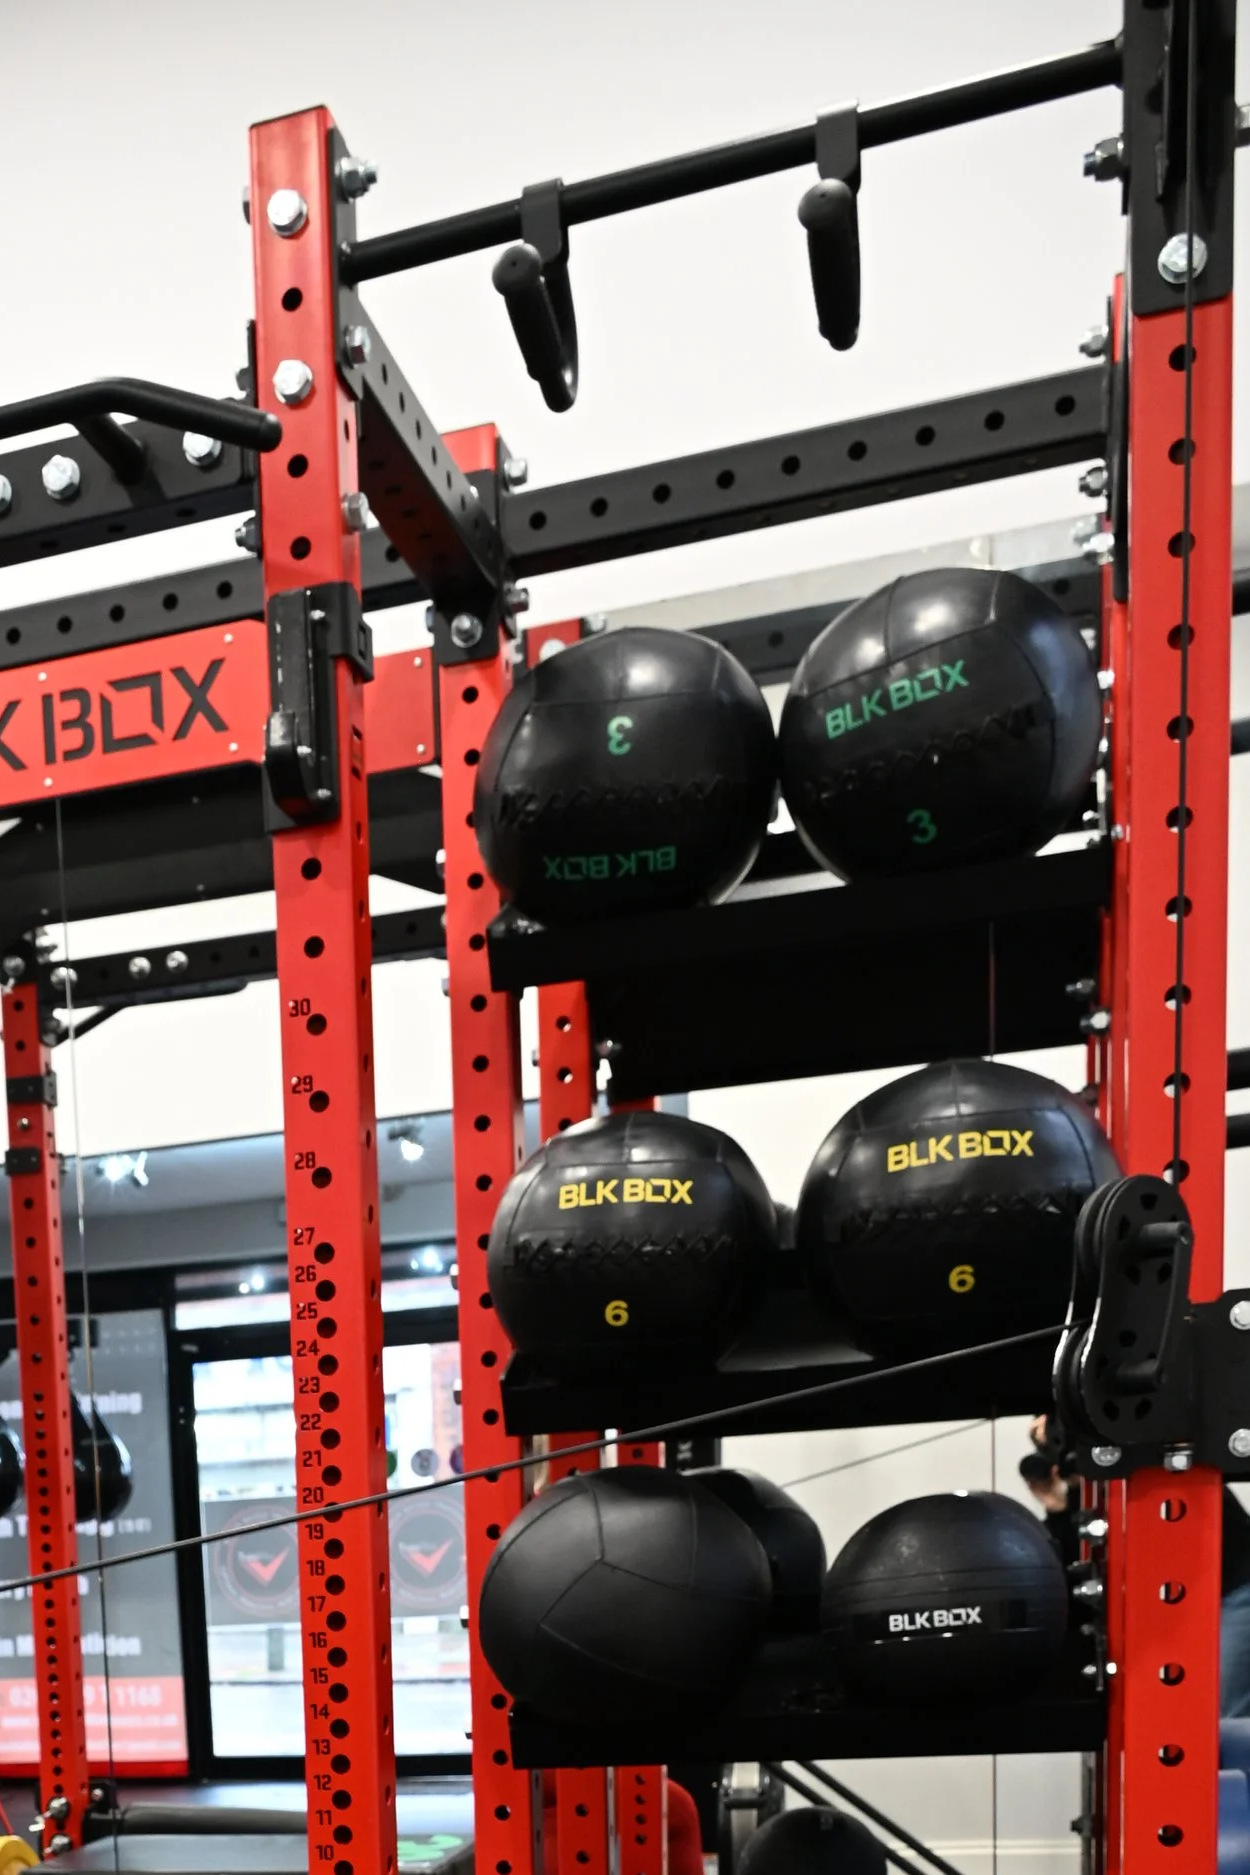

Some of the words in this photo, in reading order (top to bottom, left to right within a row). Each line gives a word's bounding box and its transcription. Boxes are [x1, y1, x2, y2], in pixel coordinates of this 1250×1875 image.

[825, 688, 888, 740] BLK
[888, 659, 970, 712] BOX
[42, 657, 230, 766] BOX
[606, 715, 634, 755] 3
[906, 808, 938, 844] 3
[614, 845, 677, 879] BLK
[289, 998, 311, 1018] 30
[291, 1075, 314, 1094] 29
[294, 1151, 316, 1170] 28
[887, 1134, 954, 1173] BLK
[957, 1129, 1034, 1160] BOX
[558, 1179, 619, 1210] BLK
[623, 1178, 694, 1205] BOX
[293, 1227, 315, 1246] 27
[295, 1264, 317, 1283] 26
[948, 1264, 975, 1293] 6
[296, 1302, 318, 1321] 25
[604, 1300, 629, 1327] 6
[296, 1339, 319, 1358] 24
[298, 1376, 320, 1394] 23
[300, 1413, 321, 1431] 22
[302, 1450, 322, 1468] 21
[302, 1486, 324, 1504] 20
[305, 1523, 324, 1540] 19
[306, 1559, 325, 1576] 18
[307, 1595, 326, 1613] 17
[888, 1610, 931, 1632] BLK
[933, 1606, 981, 1628] BOX
[308, 1631, 328, 1649] 16
[309, 1667, 329, 1685] 15
[309, 1703, 330, 1720] 14
[312, 1738, 331, 1756] 13
[313, 1773, 332, 1791] 12
[315, 1809, 332, 1825] 11
[316, 1844, 335, 1861] 10
